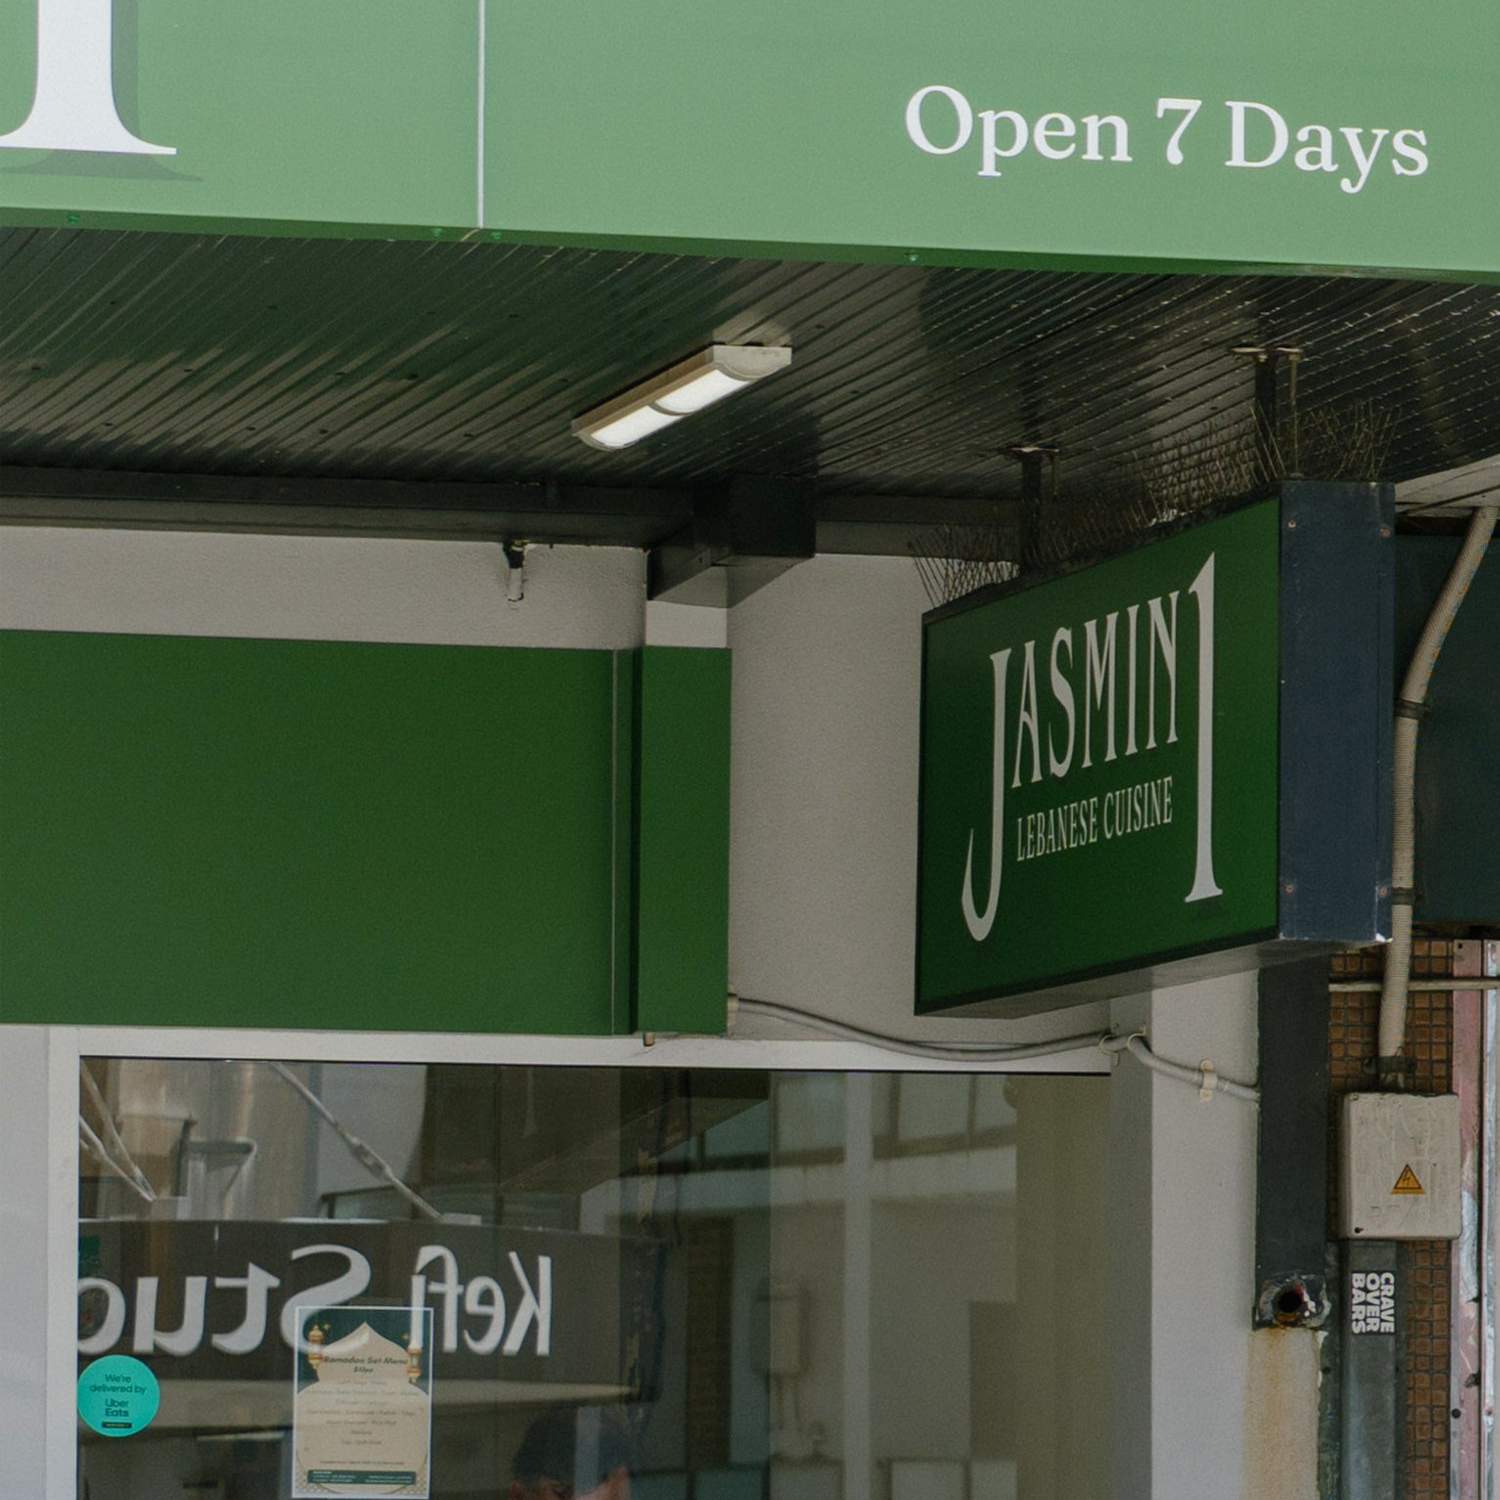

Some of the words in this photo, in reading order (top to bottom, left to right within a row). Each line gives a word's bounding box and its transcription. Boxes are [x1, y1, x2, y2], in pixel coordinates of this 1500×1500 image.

[906, 82, 1133, 179] Open
[1155, 99, 1204, 167] 7
[1226, 100, 1430, 194] Days
[1015, 798, 1100, 864] LEBANESE
[1103, 775, 1174, 849] CUISINE
[105, 1374, 132, 1384] We're
[89, 1383, 132, 1394] delivered
[133, 1384, 147, 1397] by
[104, 1399, 129, 1408] Uber
[104, 1408, 129, 1418] Eats
